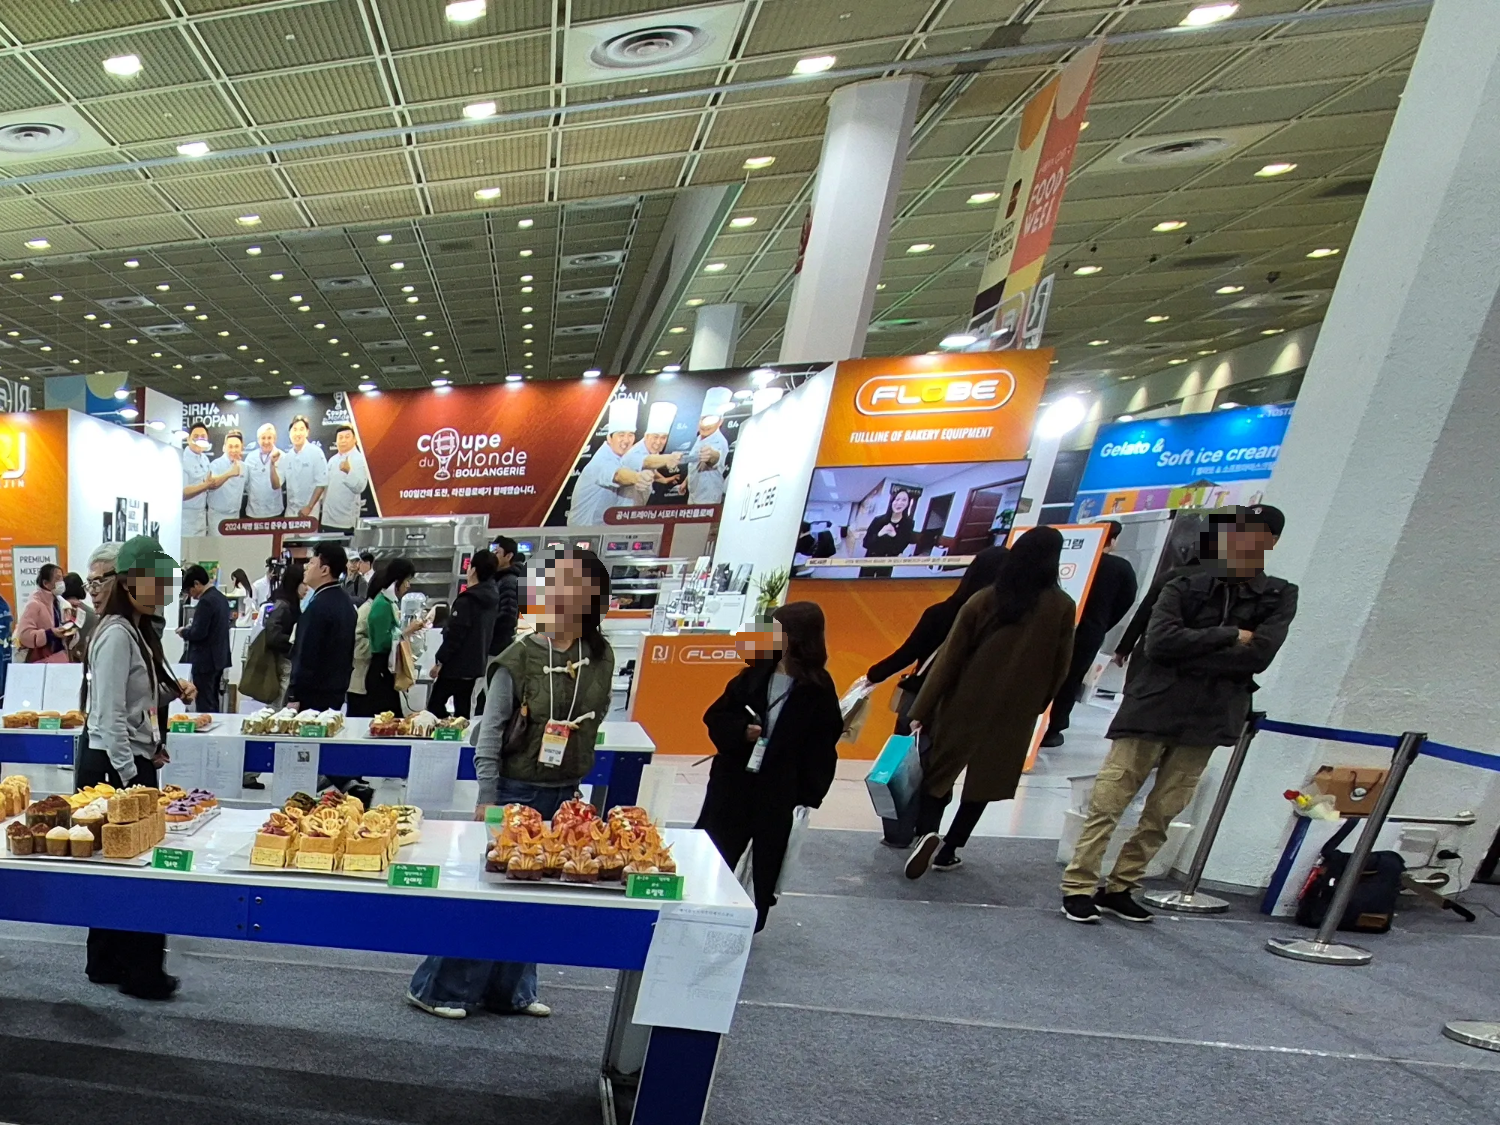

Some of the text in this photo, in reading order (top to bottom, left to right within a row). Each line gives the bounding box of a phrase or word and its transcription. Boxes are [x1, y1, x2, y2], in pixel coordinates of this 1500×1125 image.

[871, 379, 999, 405] FLOBE
[890, 430, 902, 442] OF
[904, 428, 939, 442] BAKERY
[941, 427, 994, 441] EQUIPMENT
[1101, 438, 1165, 458] Gelato &
[418, 447, 527, 467] du Monde
[1157, 449, 1193, 467] Soft
[1195, 447, 1223, 464] ice
[456, 466, 525, 478] BOULANGERIE
[616, 510, 629, 520] 공식
[225, 523, 240, 531] 2024
[19, 555, 51, 564] PREMIUM
[687, 650, 742, 660] FLOB
